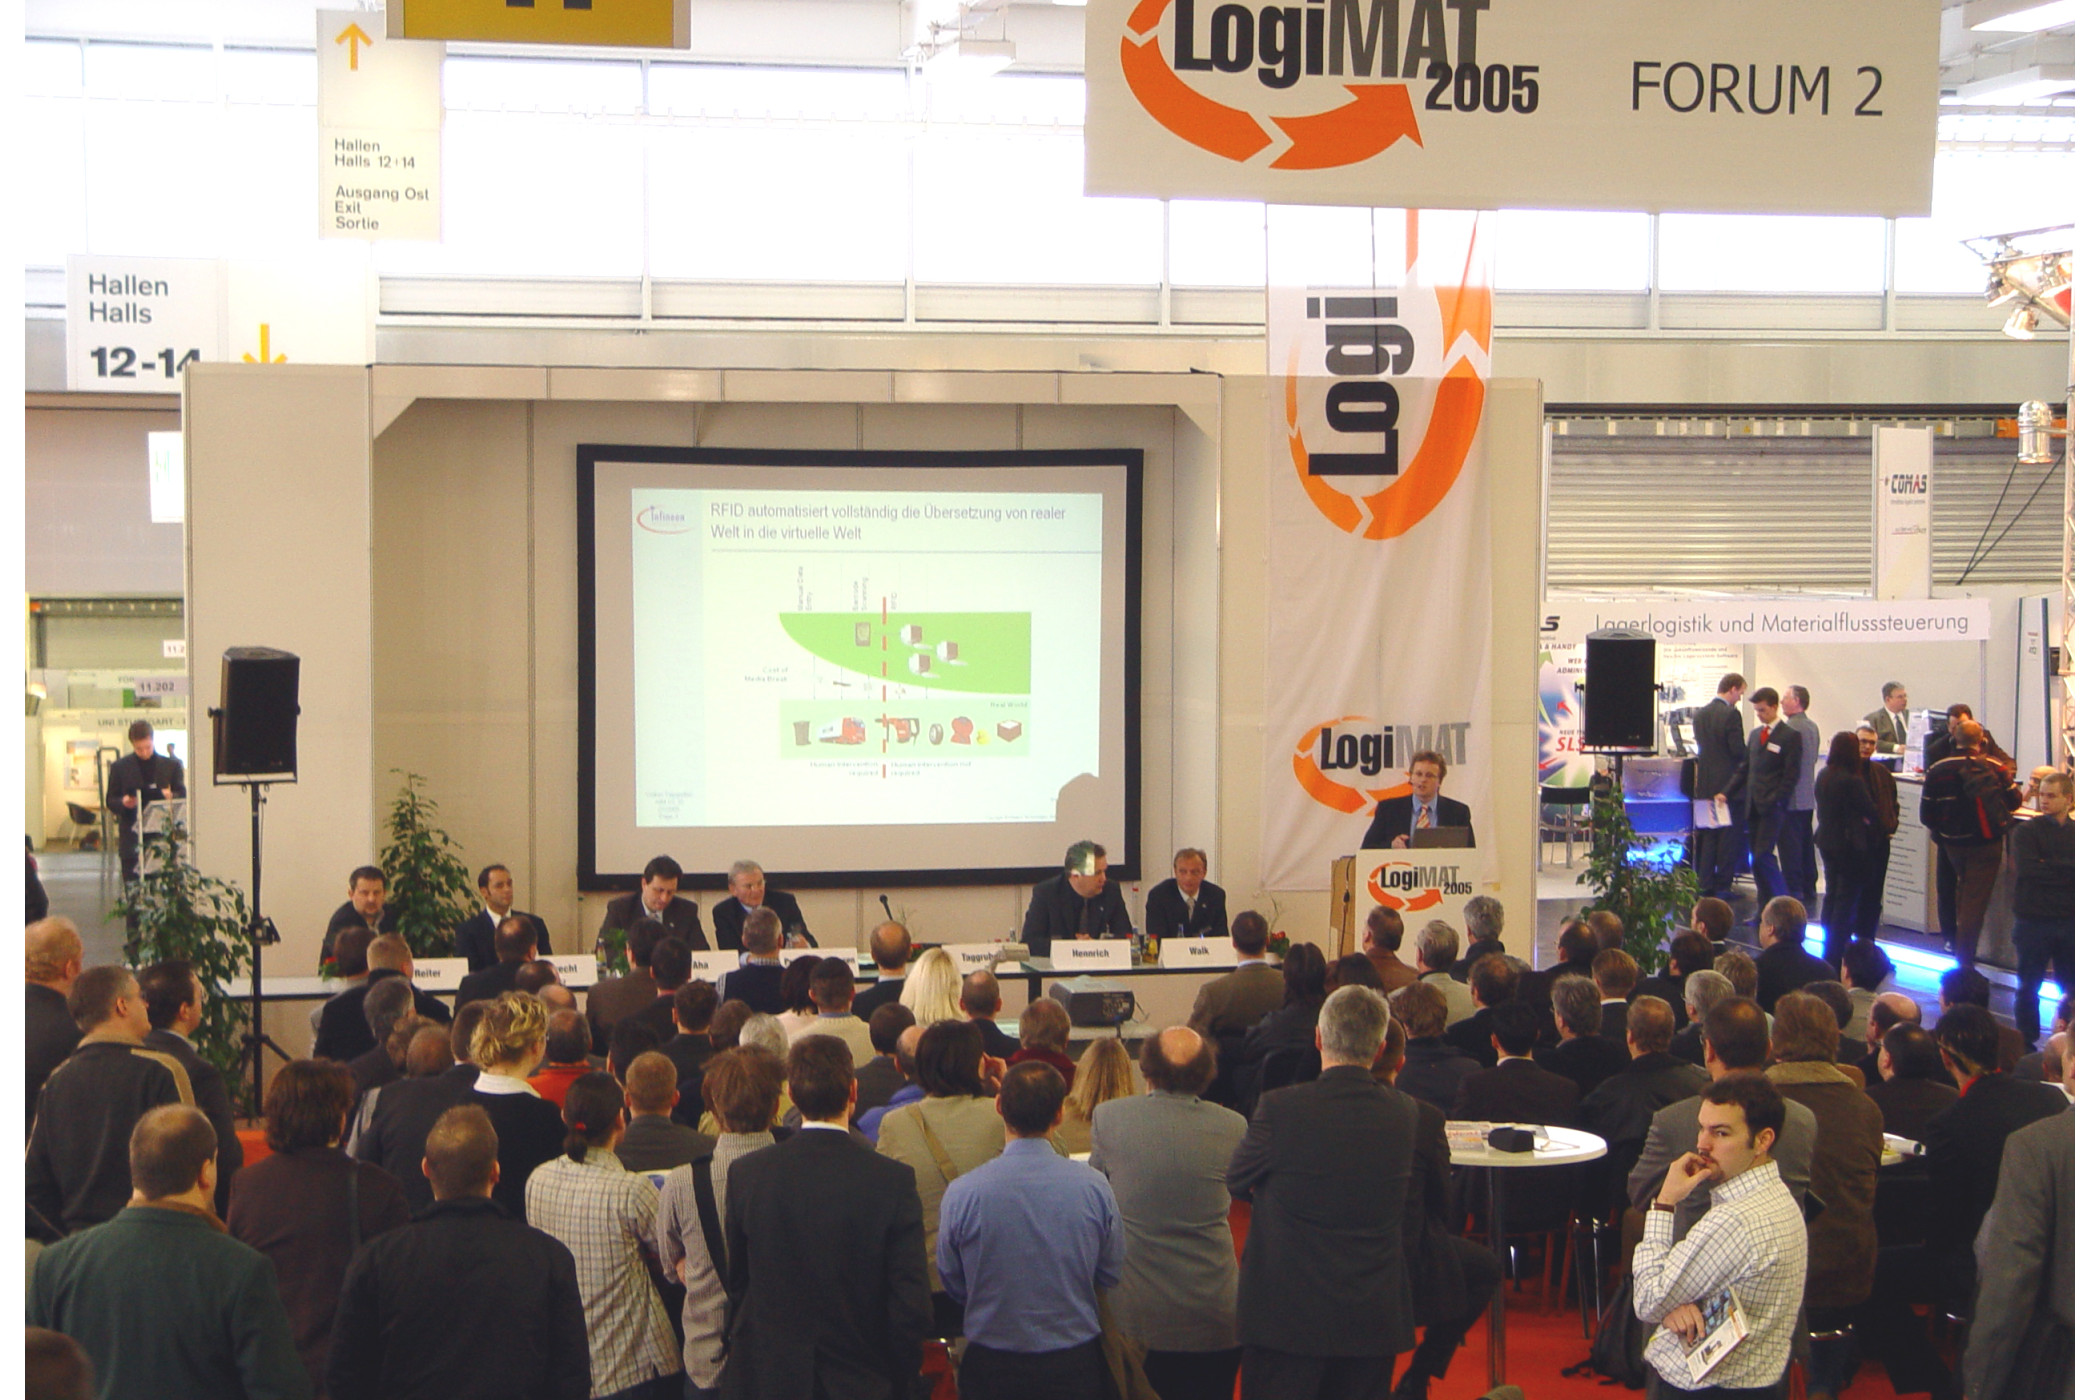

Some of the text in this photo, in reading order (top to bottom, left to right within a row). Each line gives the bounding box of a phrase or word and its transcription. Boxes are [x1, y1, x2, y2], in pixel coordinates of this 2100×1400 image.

[1173, 0, 1490, 89] LogiMAT
[1425, 62, 1540, 114] 2005
[1631, 60, 1883, 117] FORUM 2
[334, 137, 381, 152] Hallen
[334, 153, 371, 168] Halls
[336, 184, 429, 202] Ausgang Ost
[334, 200, 361, 214] Exit
[336, 215, 380, 230] Sortie
[89, 273, 168, 296] Hallen
[89, 301, 152, 324] Halls
[1890, 474, 1928, 494] COMAS
[710, 502, 1067, 522] RFID automatisiert vollständig die Übersetzung von realer
[710, 524, 862, 541] Welt in die virtuelle Welt
[1719, 611, 1754, 633] und
[1761, 612, 1969, 635] Materialflusssteuerung
[140, 681, 175, 692] 11.202
[97, 718, 115, 727] UNI
[1320, 722, 1471, 776] LogiMAT
[1380, 866, 1460, 892] LogiMAT
[1443, 882, 1473, 895] 2005
[1072, 948, 1110, 958] Hennrich
[1188, 946, 1210, 955] Walk
[414, 968, 442, 979] Reiter
